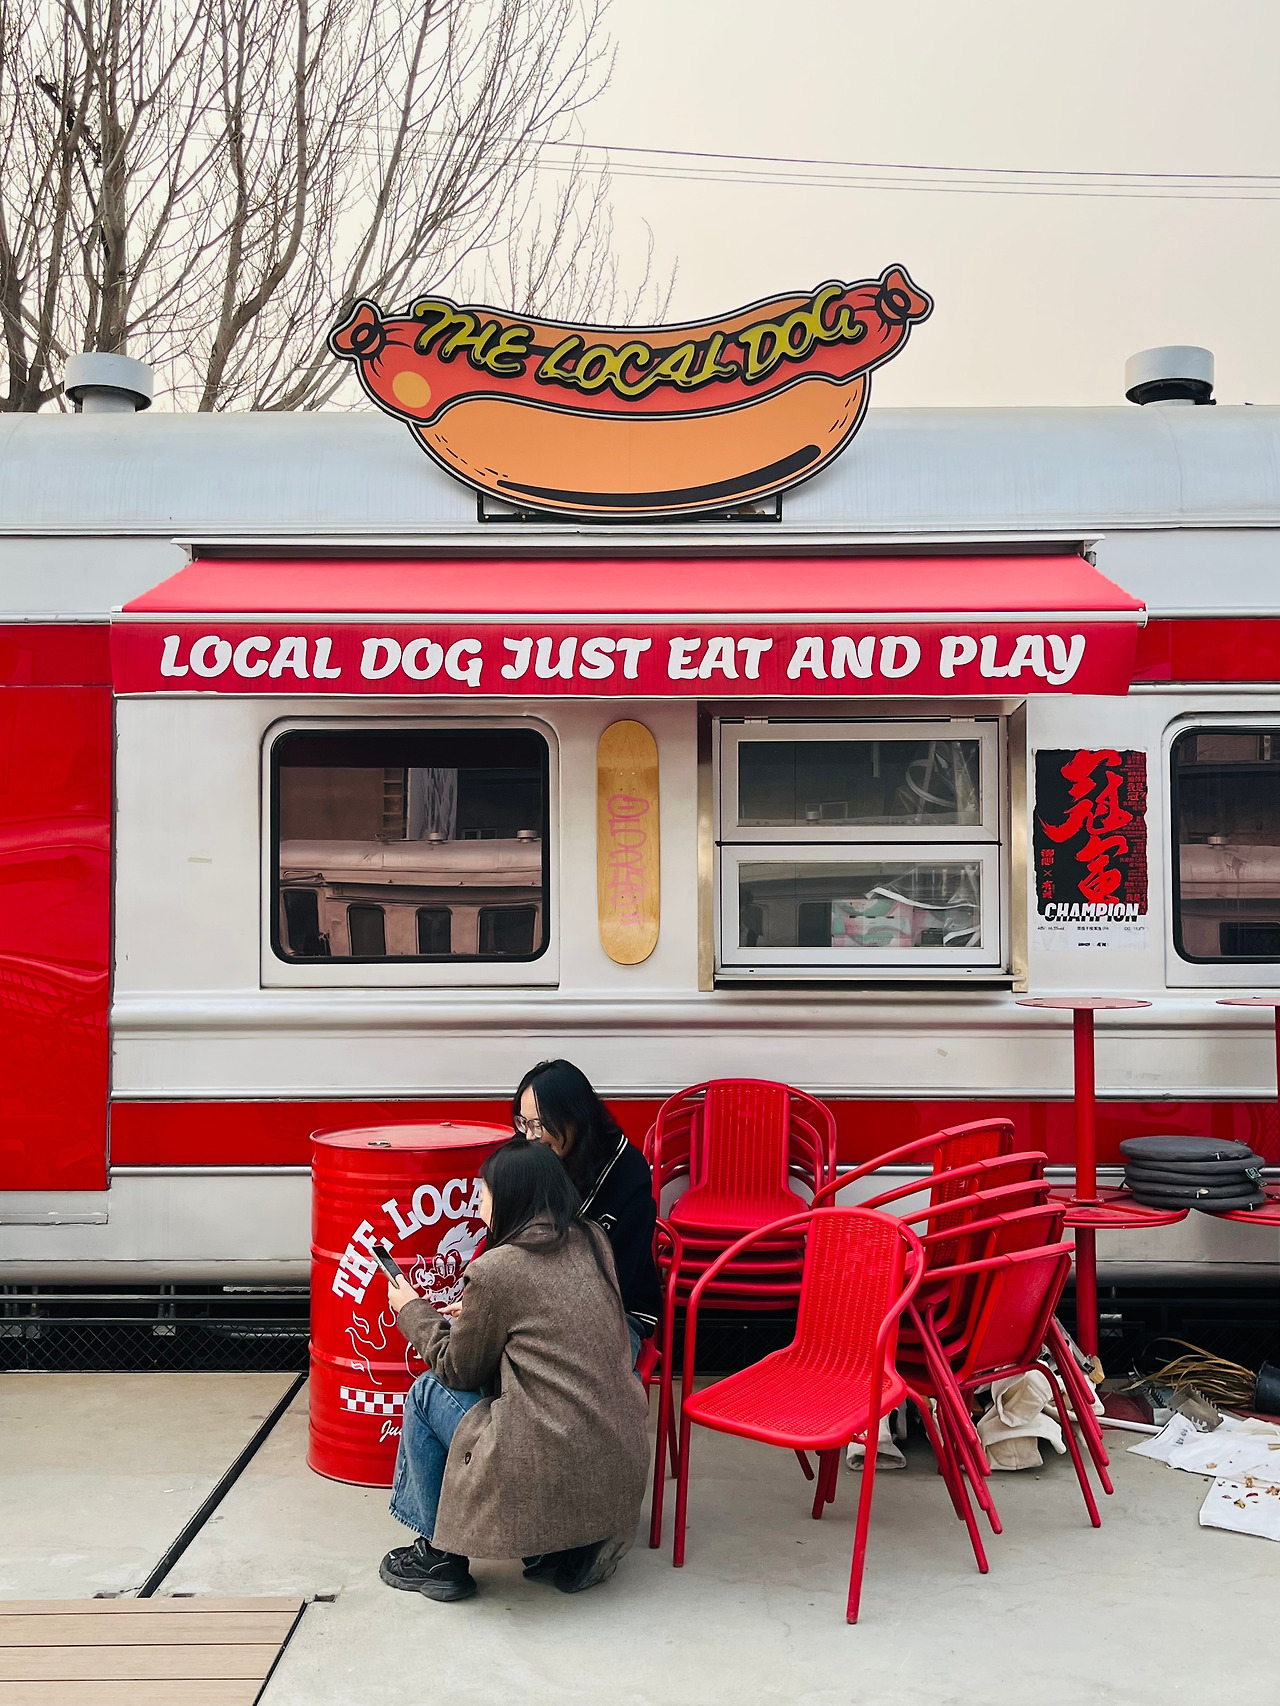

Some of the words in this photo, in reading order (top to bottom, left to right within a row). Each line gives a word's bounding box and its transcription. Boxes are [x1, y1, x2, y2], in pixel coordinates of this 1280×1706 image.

[414, 301, 530, 373] THE
[538, 334, 738, 396] LOCAL
[738, 285, 864, 380] DOG
[160, 634, 342, 679] LOCAL
[360, 637, 483, 688] DOG
[501, 636, 652, 680] JUST
[667, 636, 773, 680] EAT
[786, 635, 921, 680] AND
[939, 634, 1086, 686] PLAY
[1043, 902, 1140, 922] CHAMPION
[331, 1218, 395, 1305] THE
[378, 1419, 403, 1443] Ju
